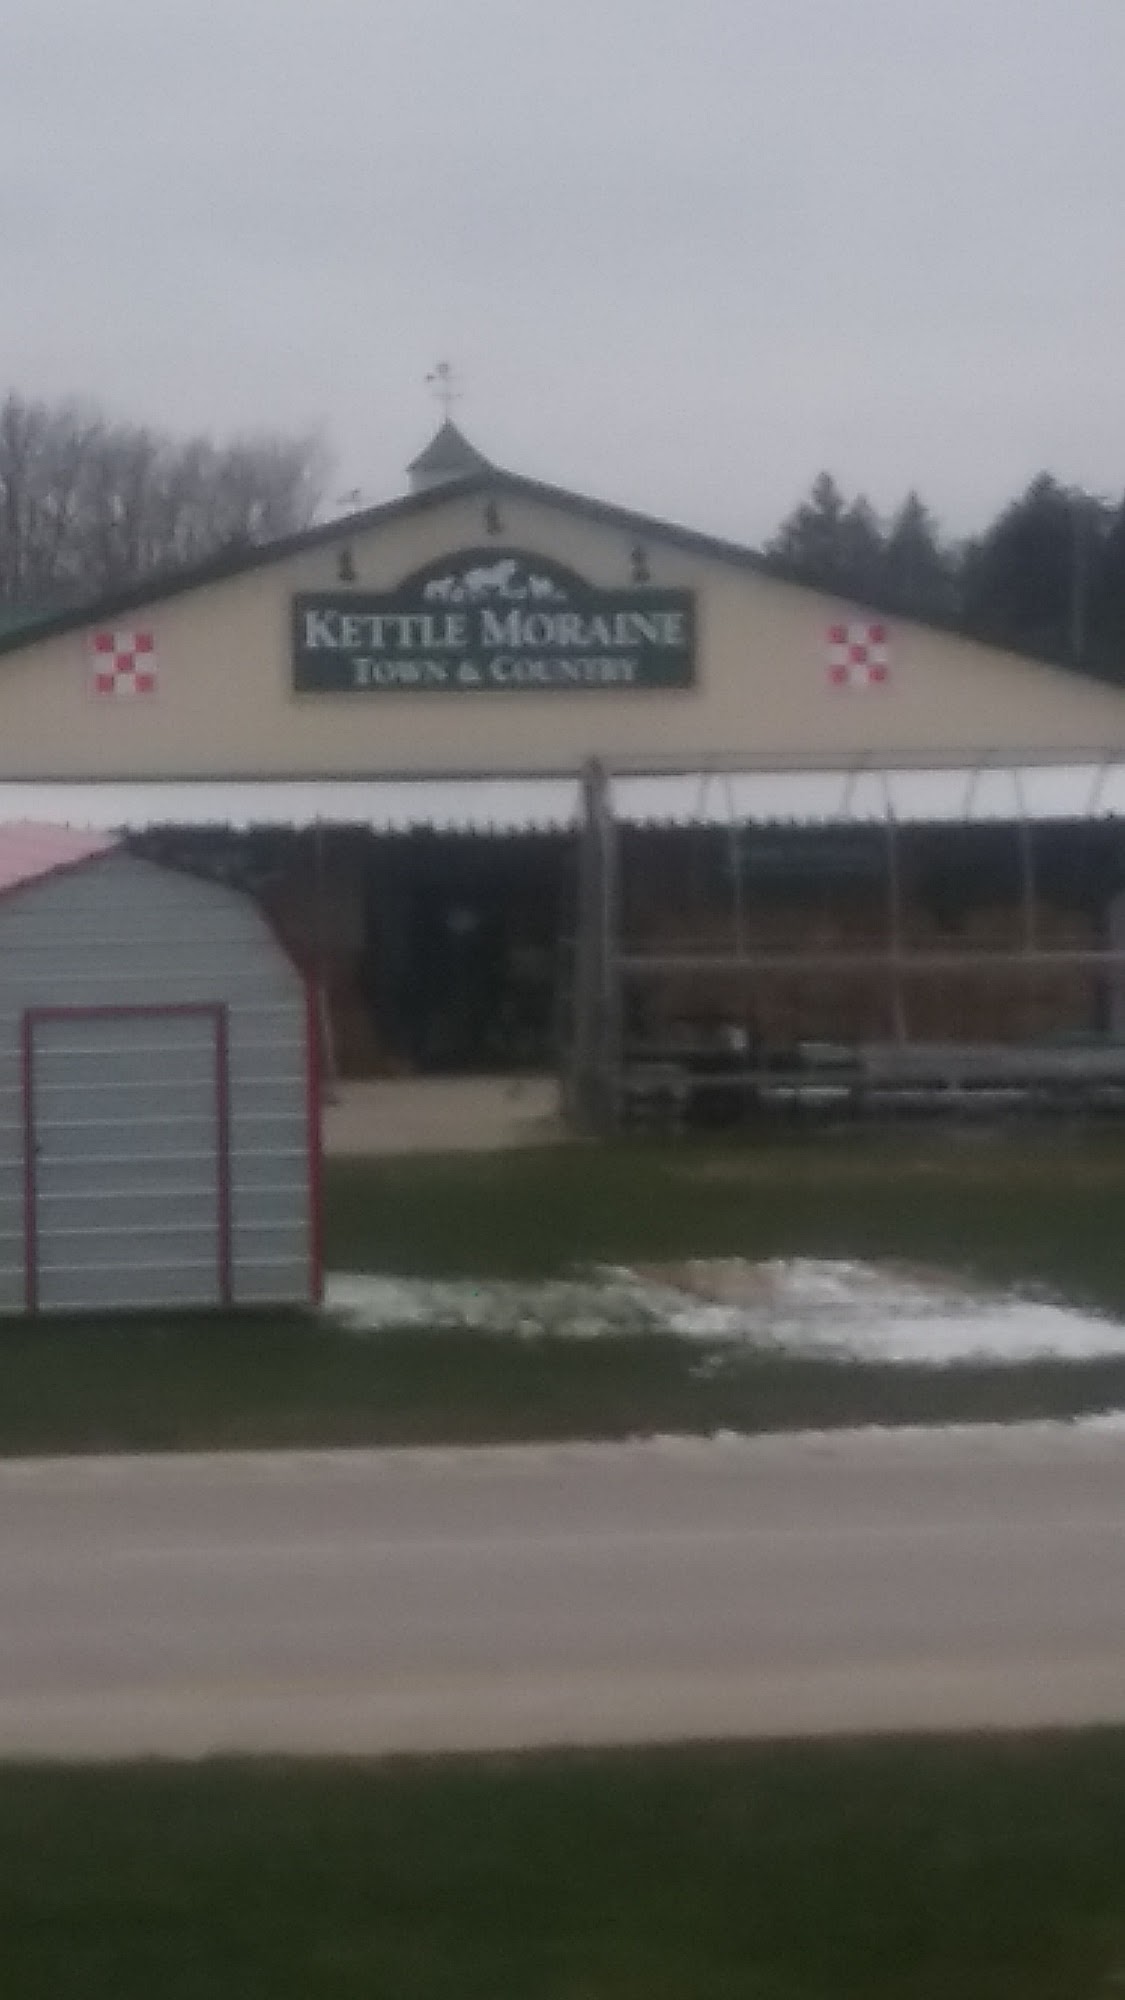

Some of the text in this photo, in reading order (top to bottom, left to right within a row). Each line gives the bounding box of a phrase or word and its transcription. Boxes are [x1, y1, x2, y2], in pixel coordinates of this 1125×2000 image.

[304, 609, 685, 648] KETTLE MORAINE
[353, 655, 638, 684] TOWN & COUNTRY
